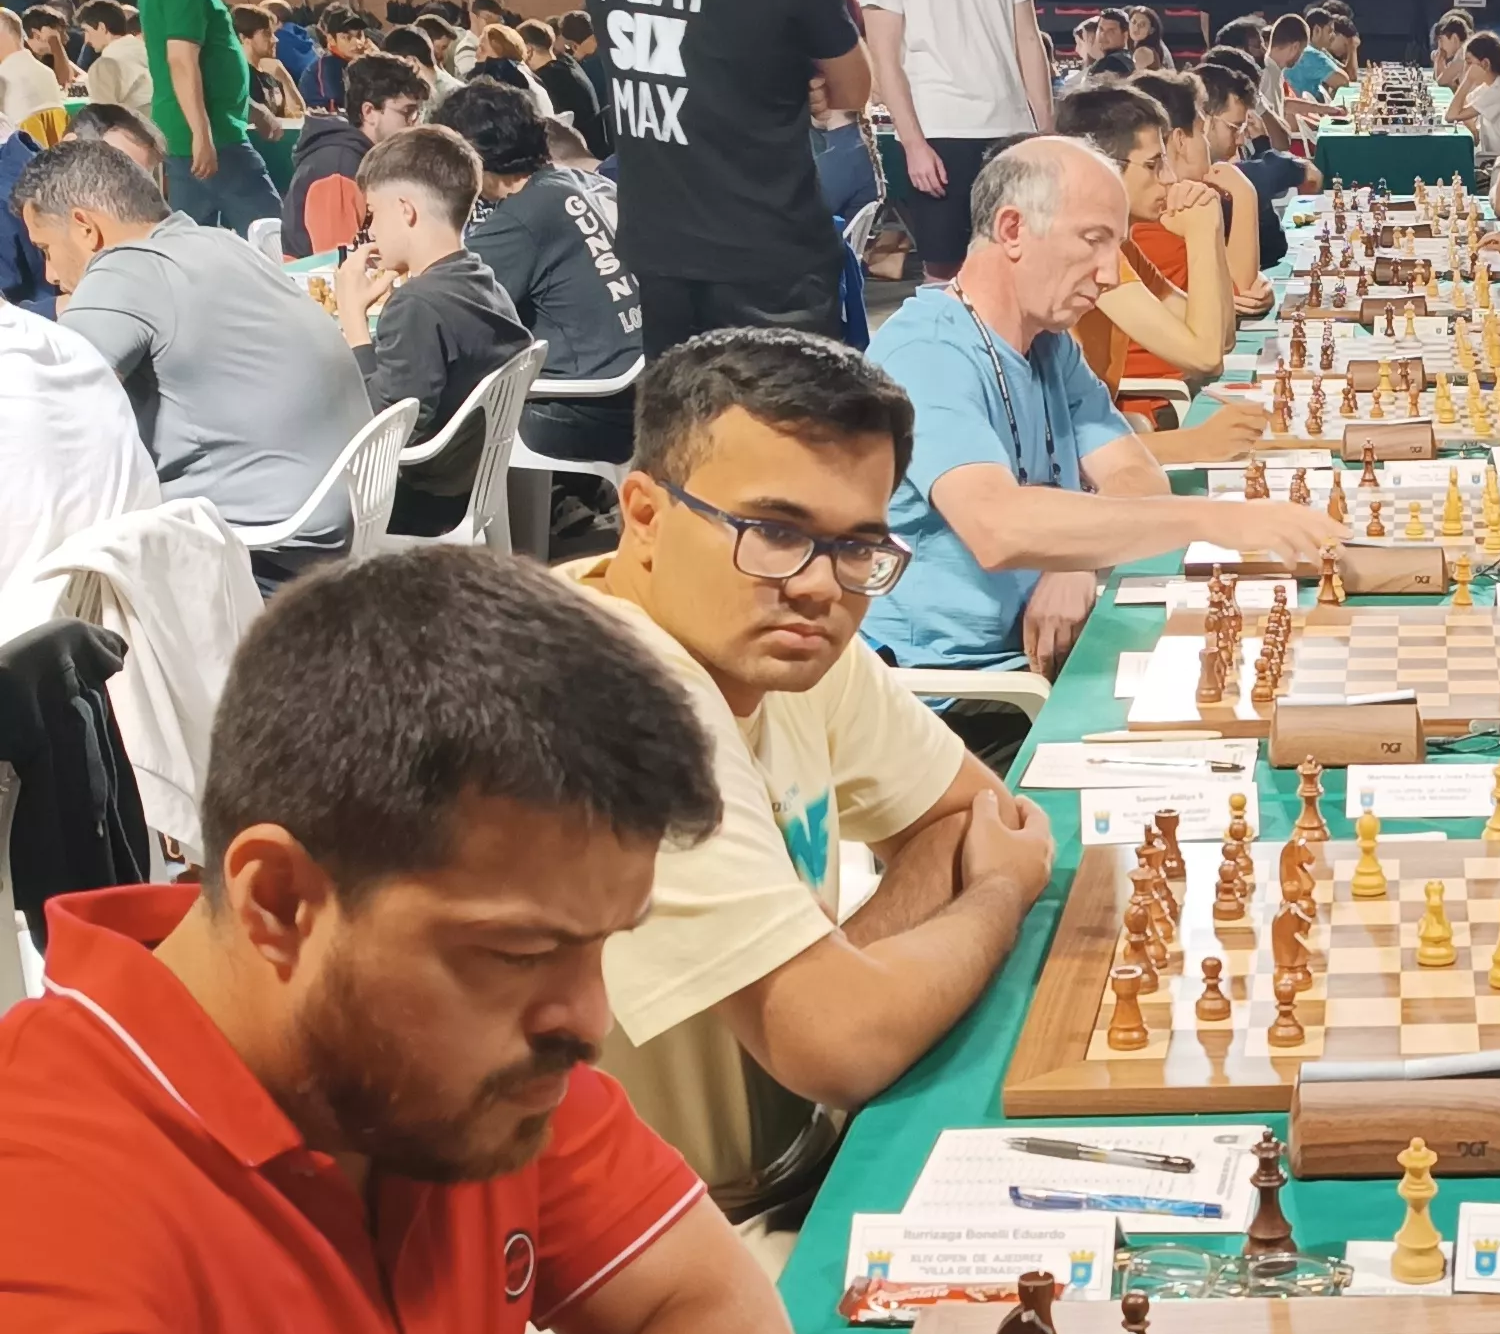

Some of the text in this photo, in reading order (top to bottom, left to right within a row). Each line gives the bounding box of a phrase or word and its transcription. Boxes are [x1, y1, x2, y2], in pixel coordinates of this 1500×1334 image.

[606, 10, 688, 78] SIX
[611, 77, 689, 146] MAX
[564, 195, 621, 276] GUNS
[1381, 742, 1402, 754] DGT
[1456, 1140, 1489, 1158] DGT
[903, 1227, 1066, 1242] Iturrizaga Bonelli Eduardo
